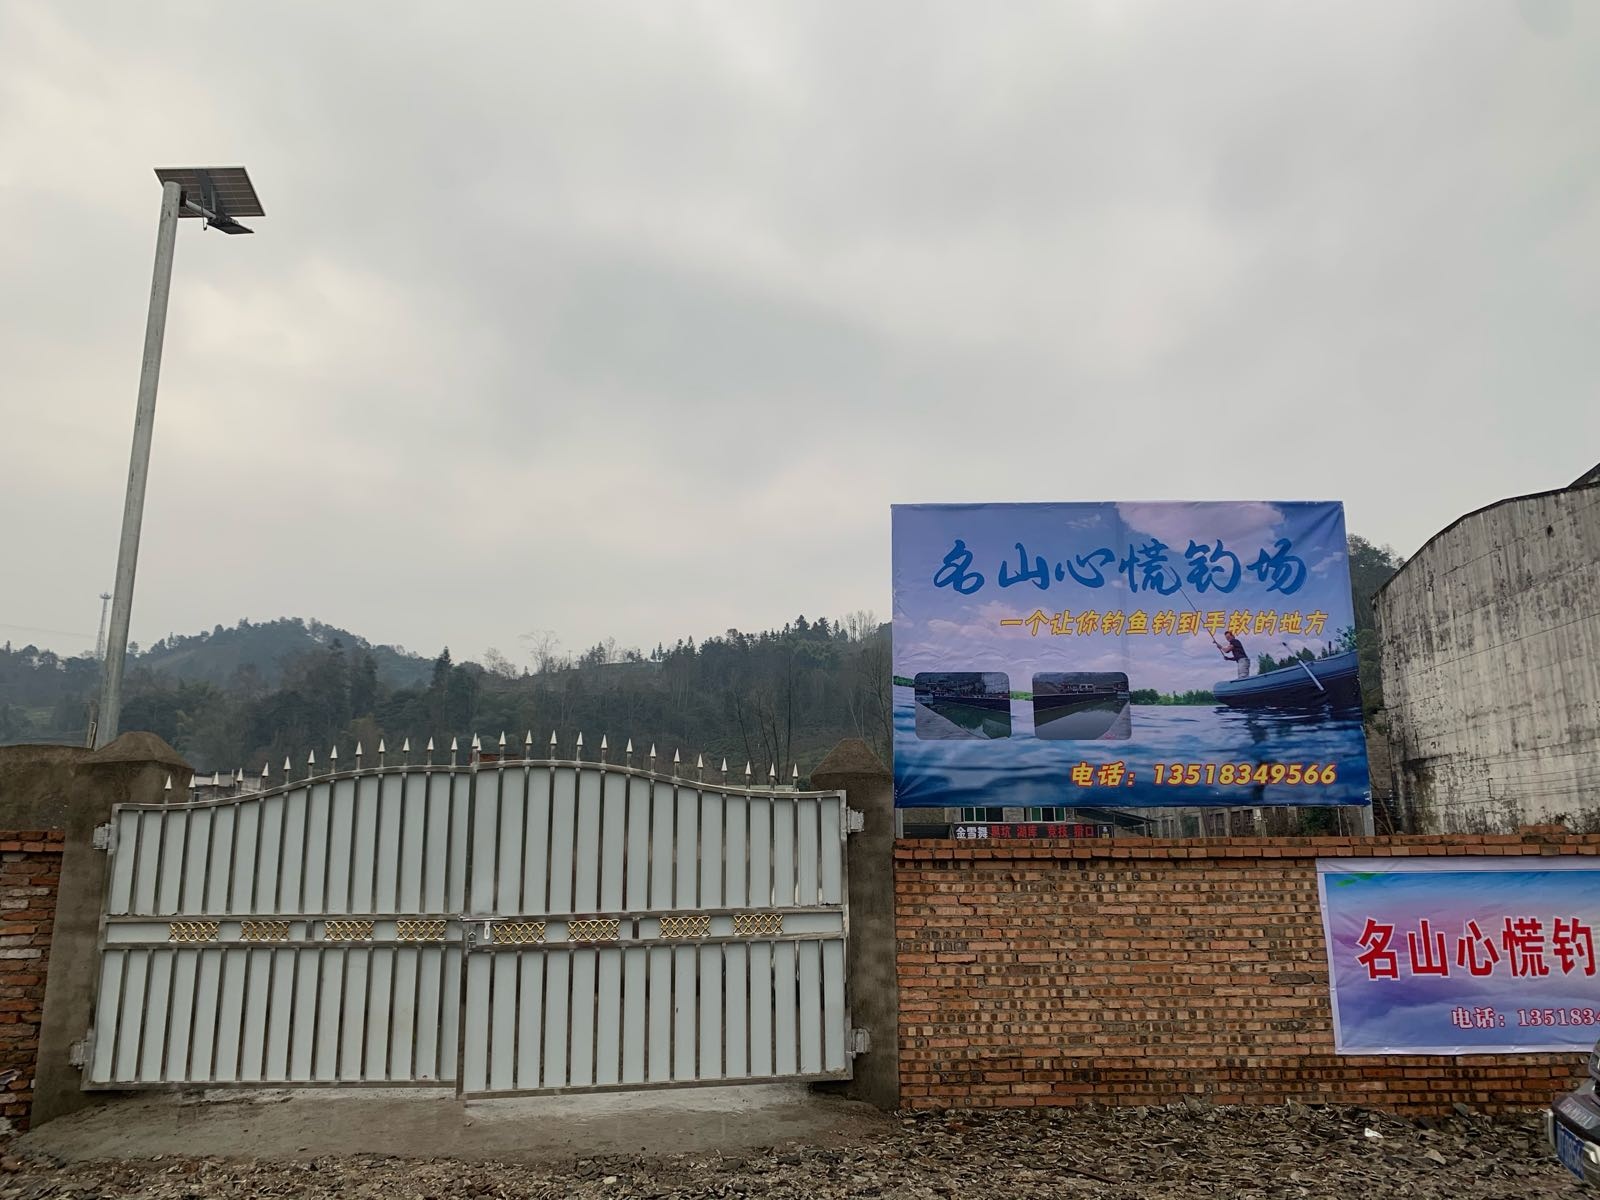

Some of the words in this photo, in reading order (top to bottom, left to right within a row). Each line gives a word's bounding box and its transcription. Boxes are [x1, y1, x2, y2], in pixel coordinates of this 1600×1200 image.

[934, 539, 1307, 595] 名山心慌钓场
[1000, 610, 1328, 636] 一个让你钓鱼钓到手软的地方
[1071, 762, 1135, 787] 电话：
[1153, 763, 1337, 786] 13518349566
[1357, 917, 1596, 980] 名山心慌钓
[1452, 1007, 1505, 1028] 电话：
